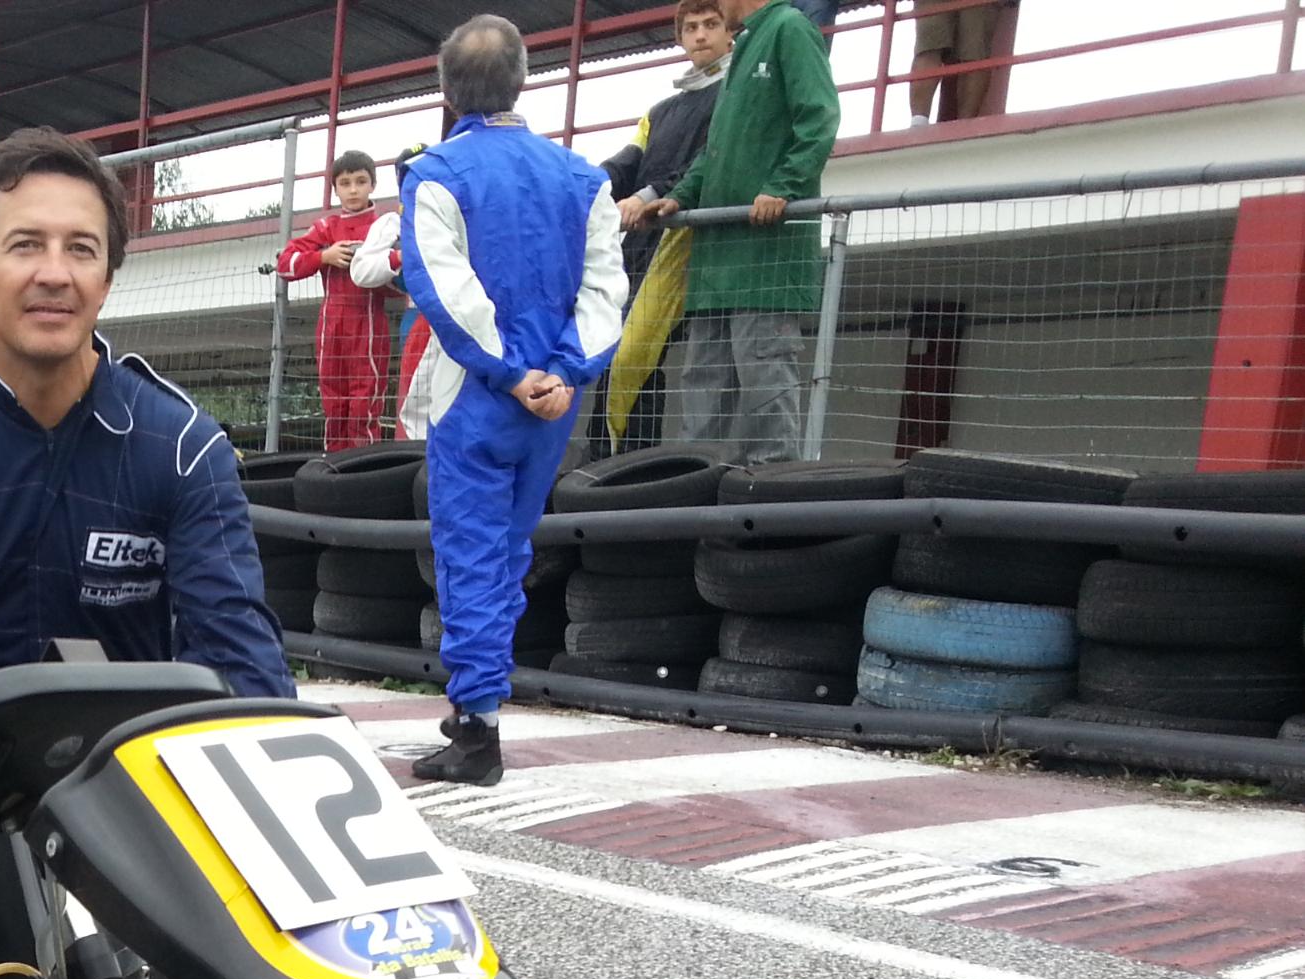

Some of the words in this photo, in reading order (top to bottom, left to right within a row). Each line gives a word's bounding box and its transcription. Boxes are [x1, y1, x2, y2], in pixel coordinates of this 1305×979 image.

[92, 537, 162, 562] Eltek
[200, 733, 444, 904] 12
[351, 906, 435, 956] 24
